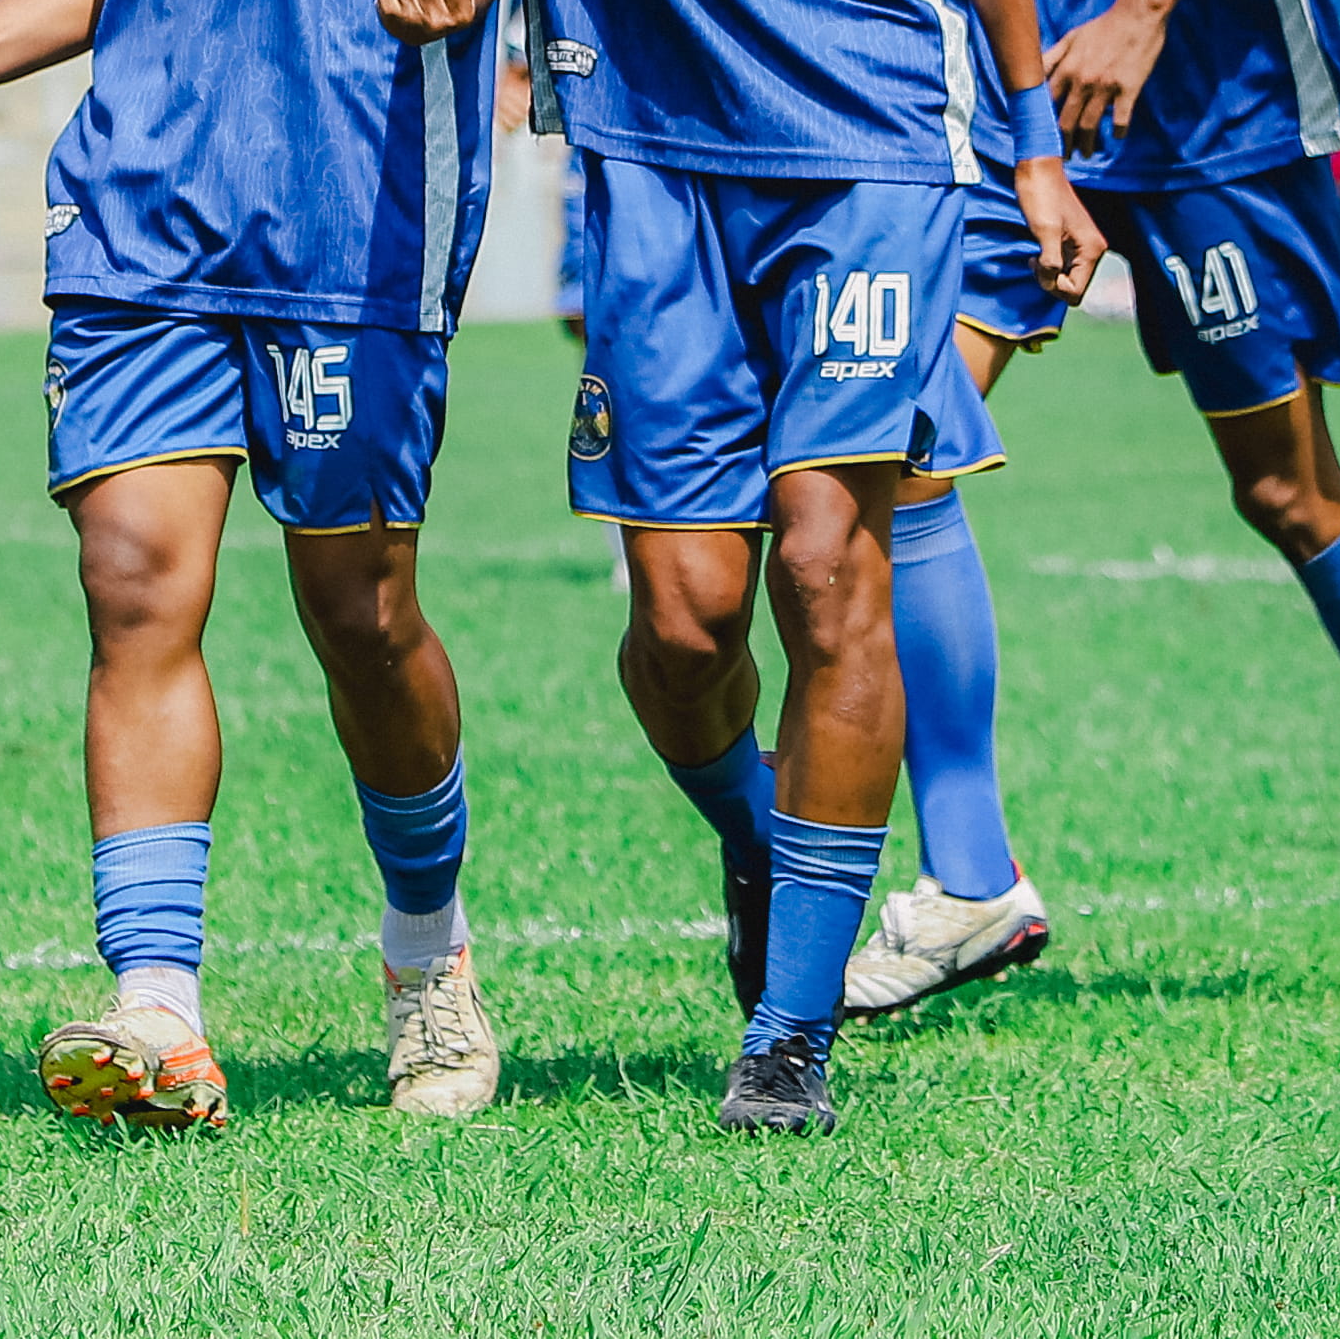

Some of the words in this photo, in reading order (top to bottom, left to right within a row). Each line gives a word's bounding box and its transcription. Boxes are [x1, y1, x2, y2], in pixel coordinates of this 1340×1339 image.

[1164, 241, 1258, 326] 141
[813, 271, 910, 357] 140
[1198, 314, 1260, 344] apex
[266, 344, 353, 430] 145
[820, 361, 897, 382] apex
[286, 429, 341, 450] apex
